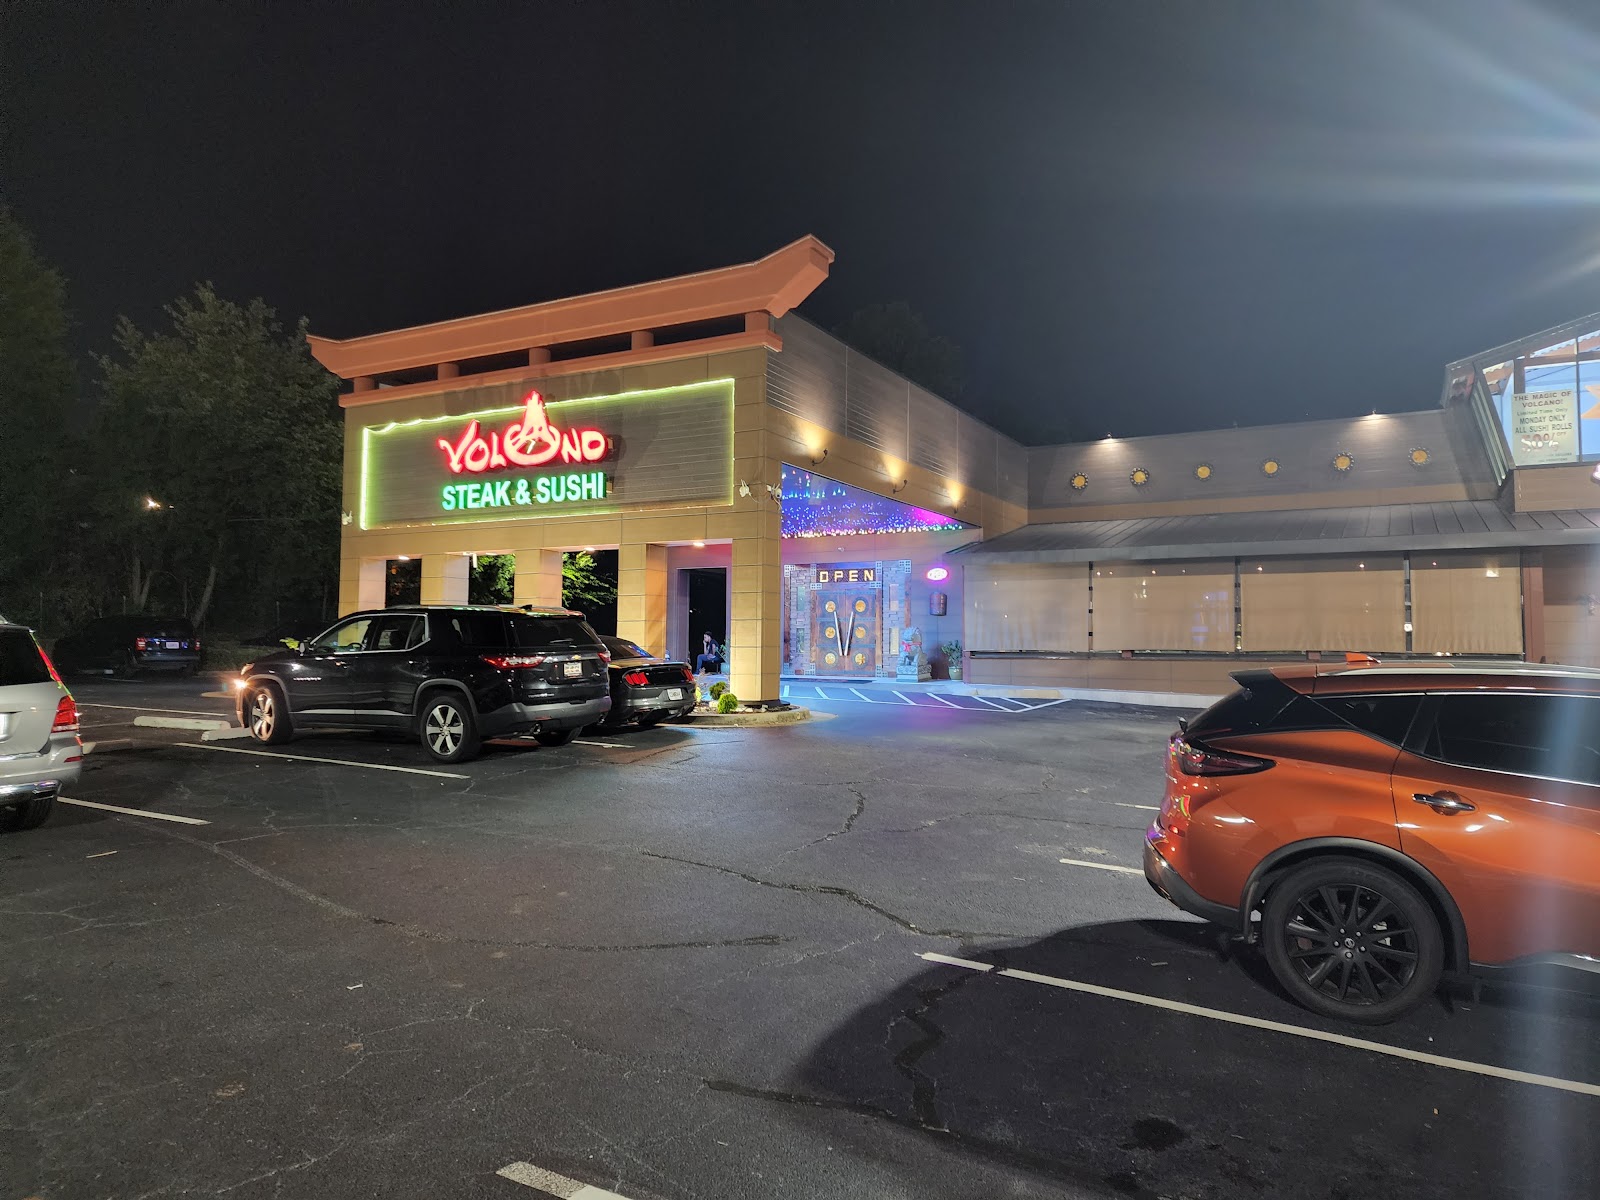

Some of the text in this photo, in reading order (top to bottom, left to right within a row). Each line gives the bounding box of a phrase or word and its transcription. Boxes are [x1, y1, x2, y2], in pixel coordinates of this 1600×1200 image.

[1520, 416, 1546, 424] MONDAY
[1515, 426, 1527, 434] ALL
[442, 471, 606, 511] STEAK & SUSHI
[819, 569, 874, 583] OPEN
